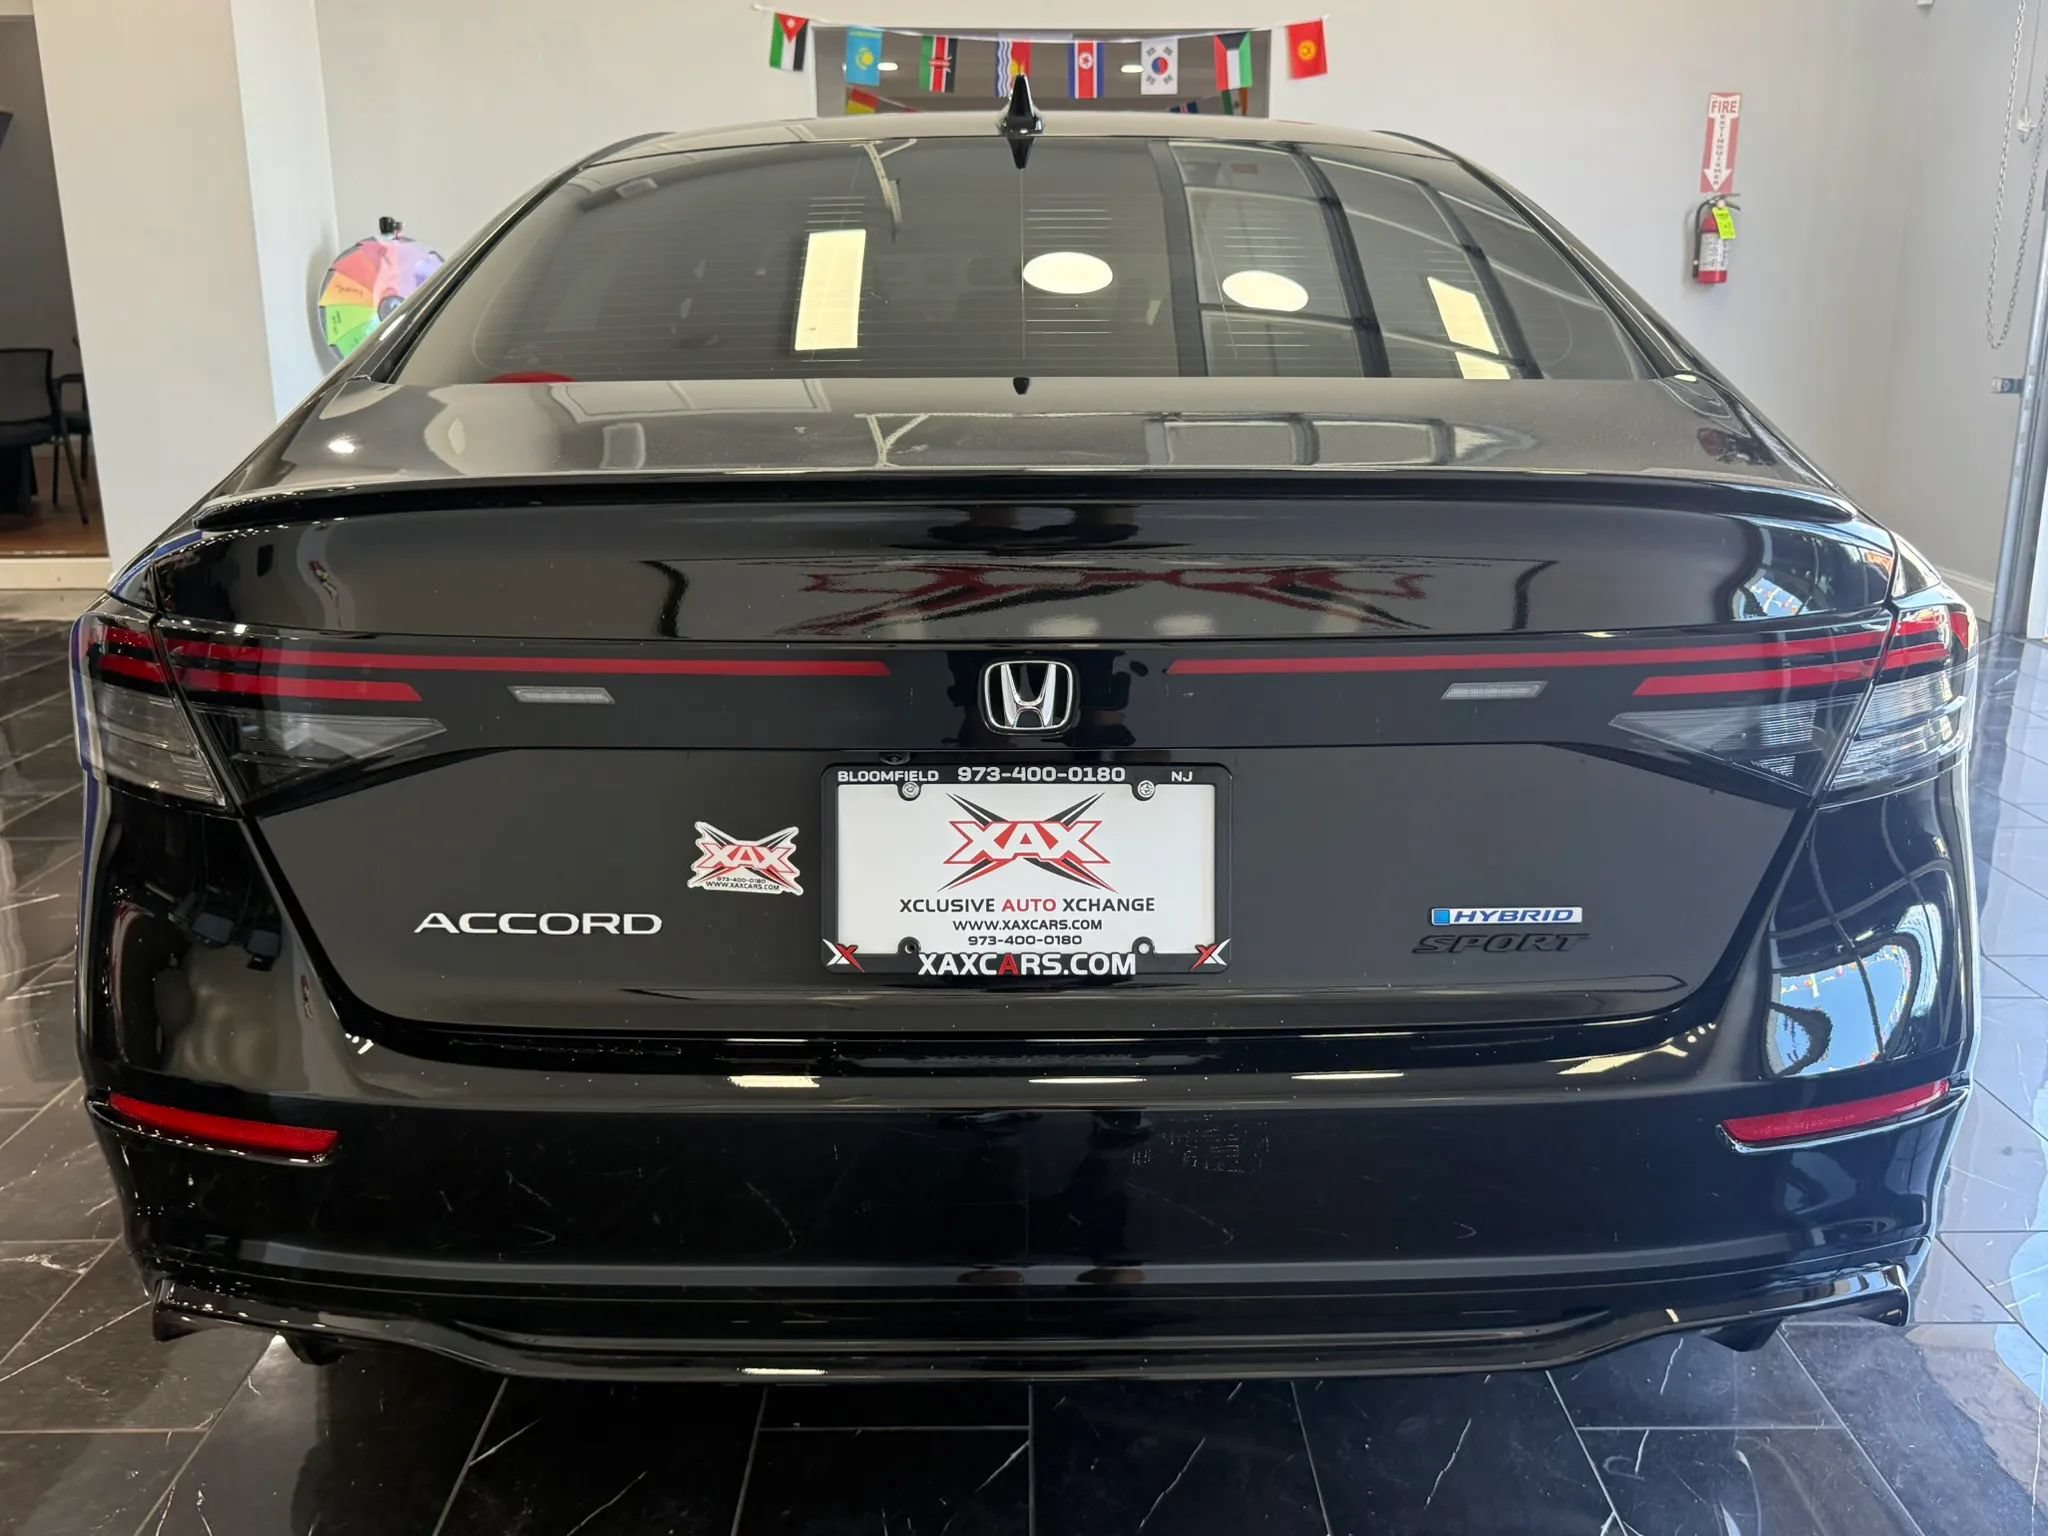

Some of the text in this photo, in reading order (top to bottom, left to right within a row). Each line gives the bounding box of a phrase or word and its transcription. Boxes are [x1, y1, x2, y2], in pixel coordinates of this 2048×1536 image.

[1710, 100, 1738, 114] FIRE
[837, 766, 1193, 783] BLOOMFIELD 973-400-0180 NJ
[943, 820, 1111, 864] XAX
[697, 843, 795, 873] XAX
[706, 881, 780, 890] WWW.XAXCARS.COM
[899, 897, 1156, 913] XCLUSIVE AUTO XCHANGE
[413, 912, 663, 935] ACCORD
[1453, 909, 1574, 923] HYBRID
[952, 919, 1103, 931] WWW.XAXCARS.COM
[967, 935, 1083, 946] 973-400-0180
[1411, 933, 1590, 954] SPORT
[917, 952, 1137, 976] XAXCARS.COM
